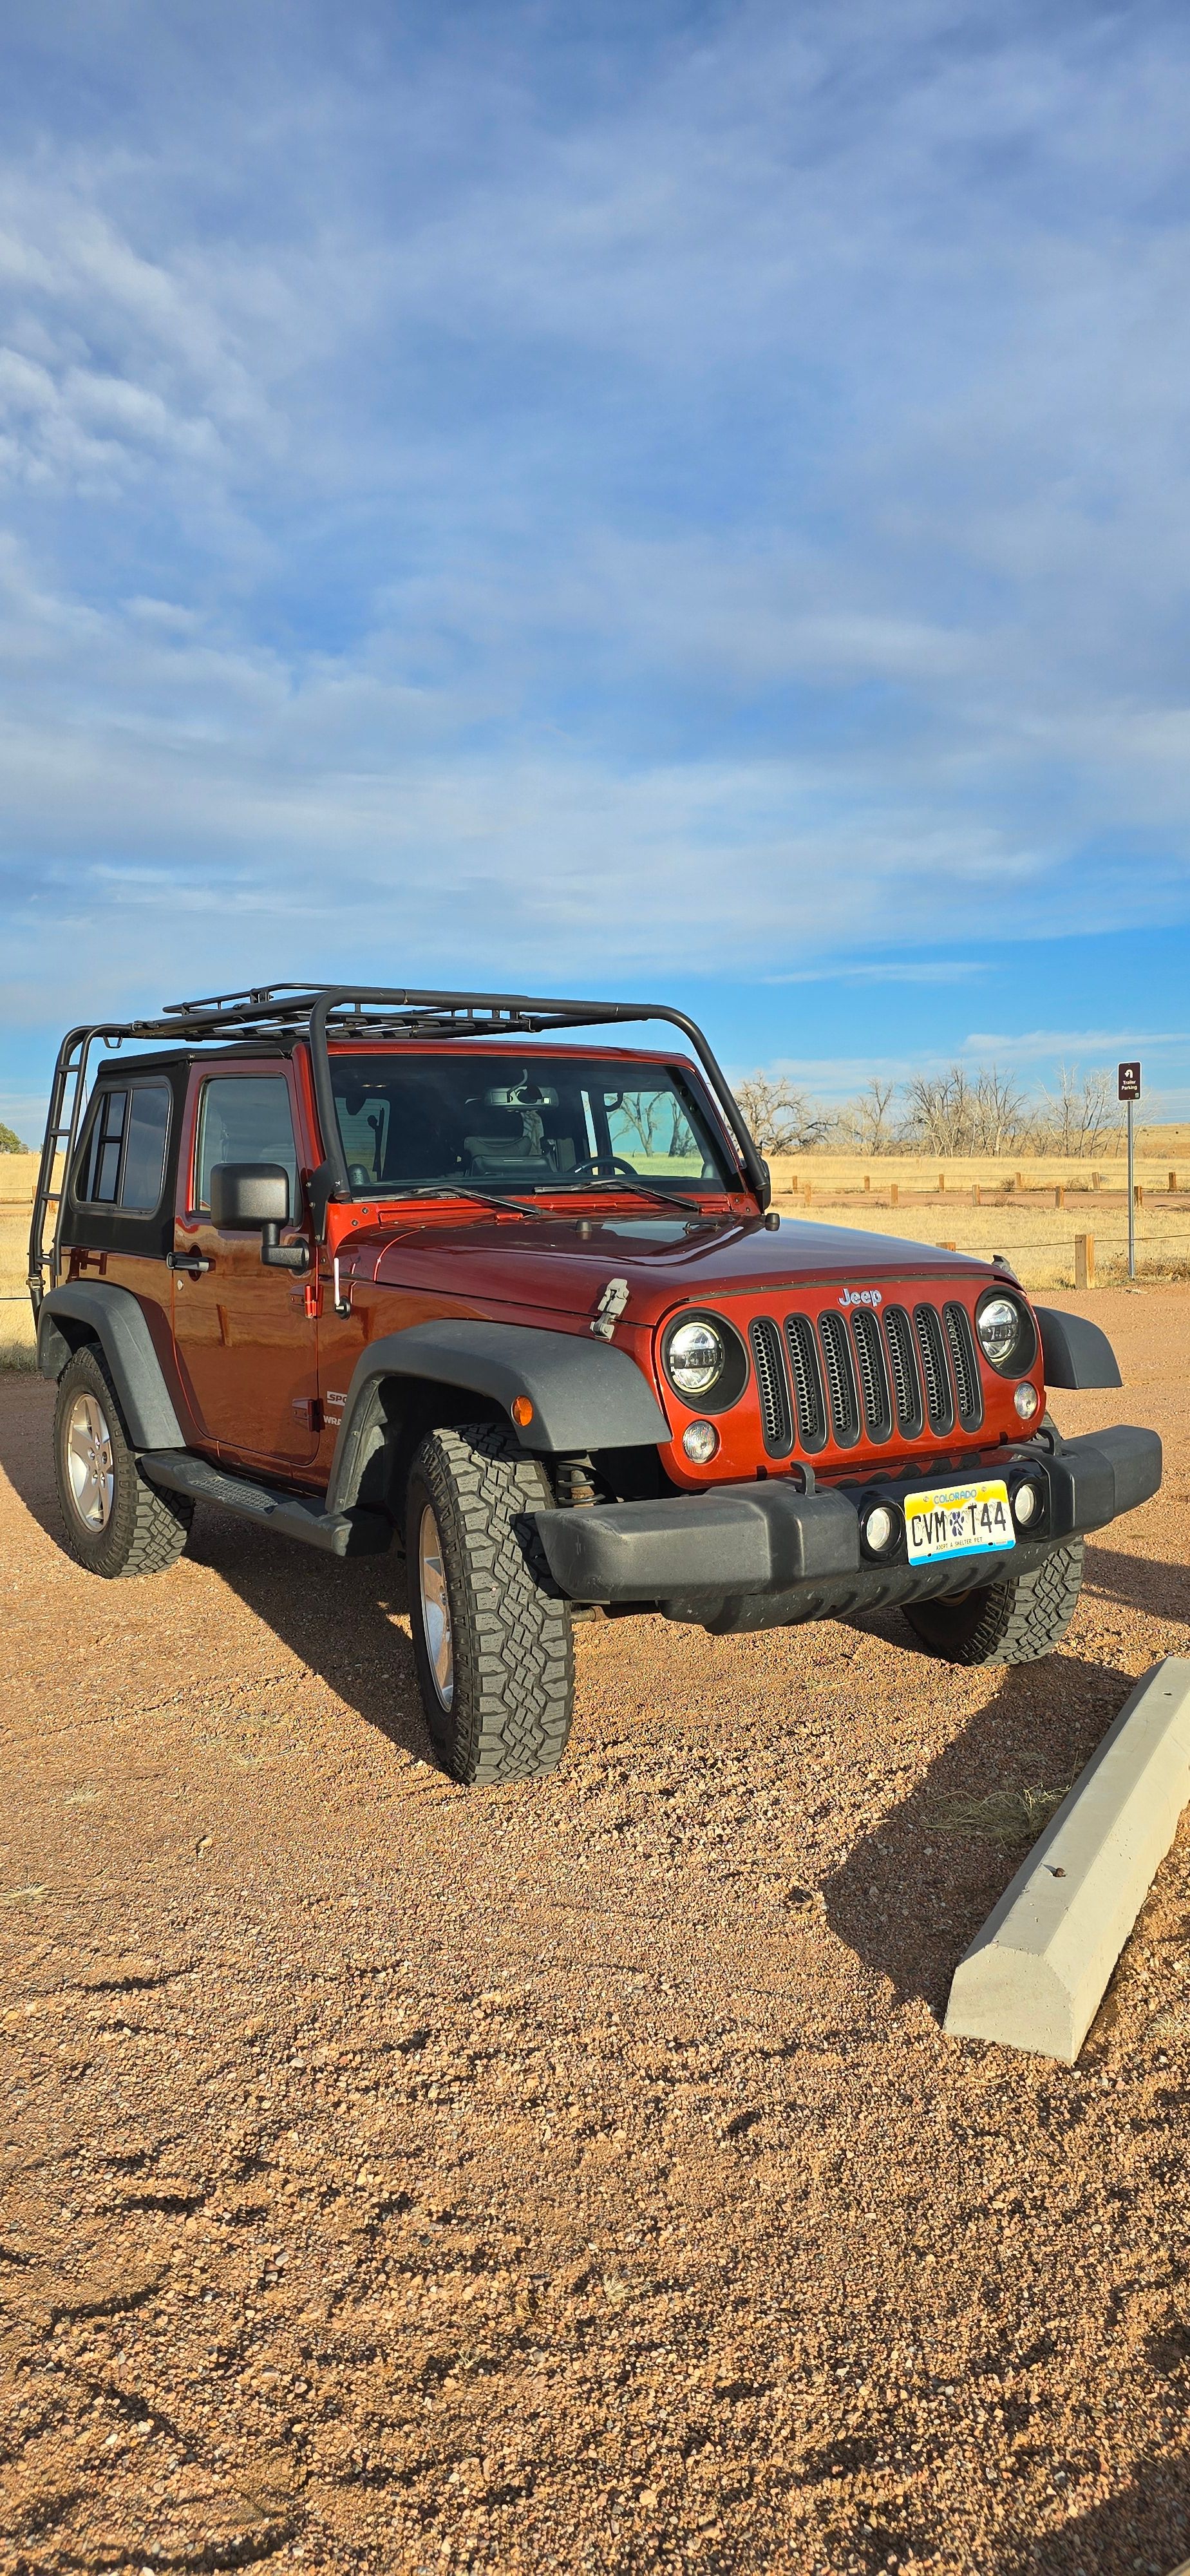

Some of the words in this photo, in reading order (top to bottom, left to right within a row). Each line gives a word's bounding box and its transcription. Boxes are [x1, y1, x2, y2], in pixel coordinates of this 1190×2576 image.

[838, 1288, 882, 1307] Jeep
[329, 1394, 347, 1403] SPO
[934, 1489, 976, 1504] COLORADO
[911, 1511, 947, 1547] CVM
[968, 1501, 1006, 1535] T44
[936, 1542, 948, 1551] ADOPT
